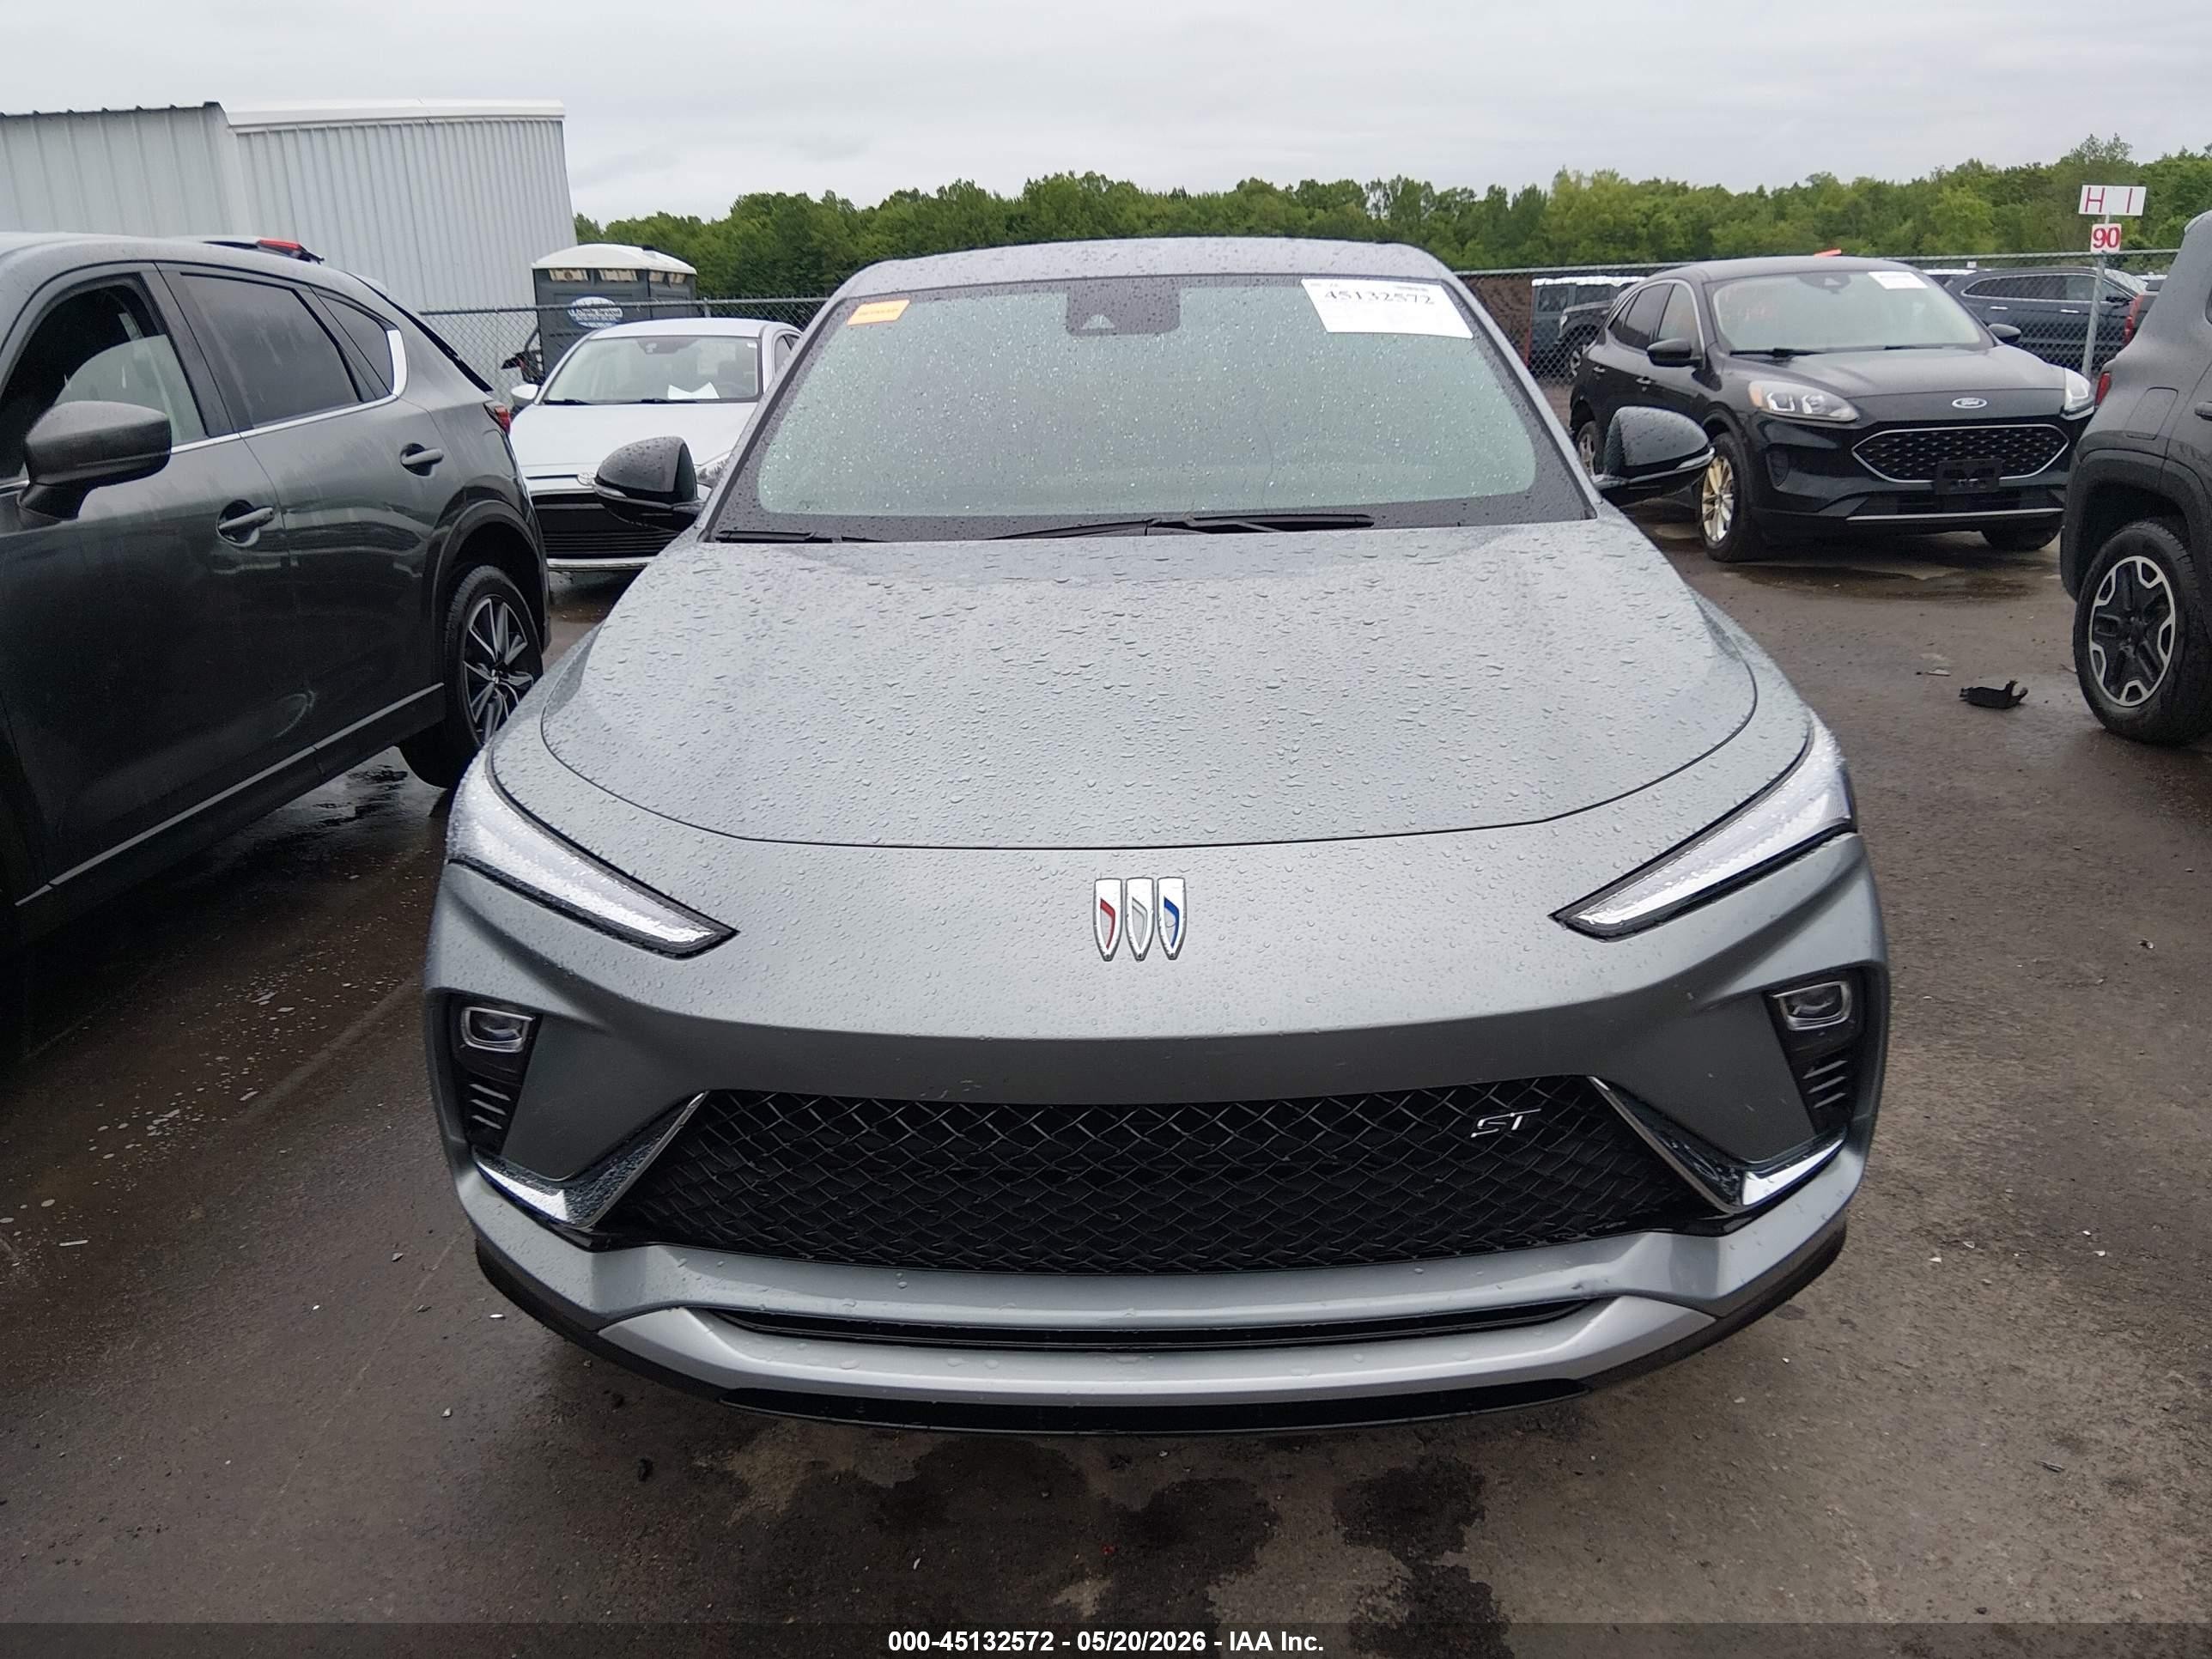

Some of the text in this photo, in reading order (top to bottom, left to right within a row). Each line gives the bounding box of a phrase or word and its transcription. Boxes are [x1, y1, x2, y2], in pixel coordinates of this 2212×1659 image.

[2084, 186, 2106, 213] H
[2093, 227, 2120, 249] 90
[1324, 290, 1436, 306] 45132572
[1470, 1108, 1542, 1139] ST
